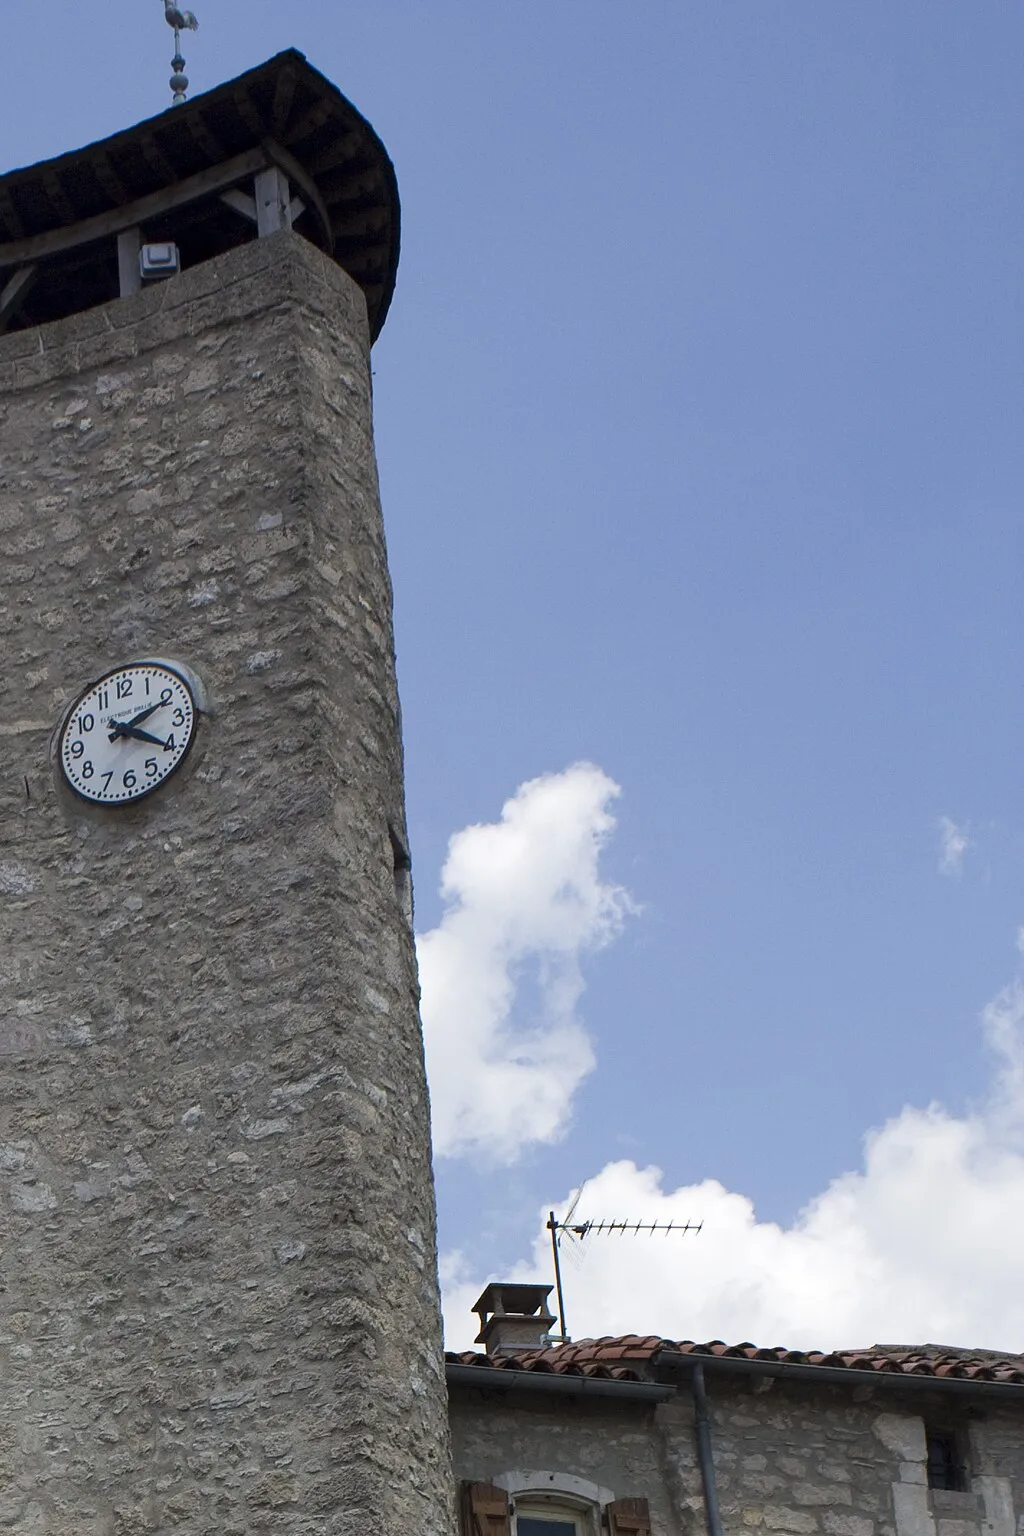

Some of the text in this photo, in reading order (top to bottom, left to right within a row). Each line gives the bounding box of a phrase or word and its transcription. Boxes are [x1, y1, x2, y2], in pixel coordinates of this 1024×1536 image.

[116, 679, 133, 699] 12
[145, 677, 150, 695] 1
[98, 691, 109, 711] 11
[160, 688, 173, 707] 2
[78, 713, 94, 735] 10
[172, 708, 185, 727] 3
[70, 740, 84, 759] 9
[163, 733, 177, 752] 4
[81, 760, 94, 779] 8
[144, 757, 158, 777] 5
[100, 771, 114, 792] 7
[122, 769, 136, 788] 6
